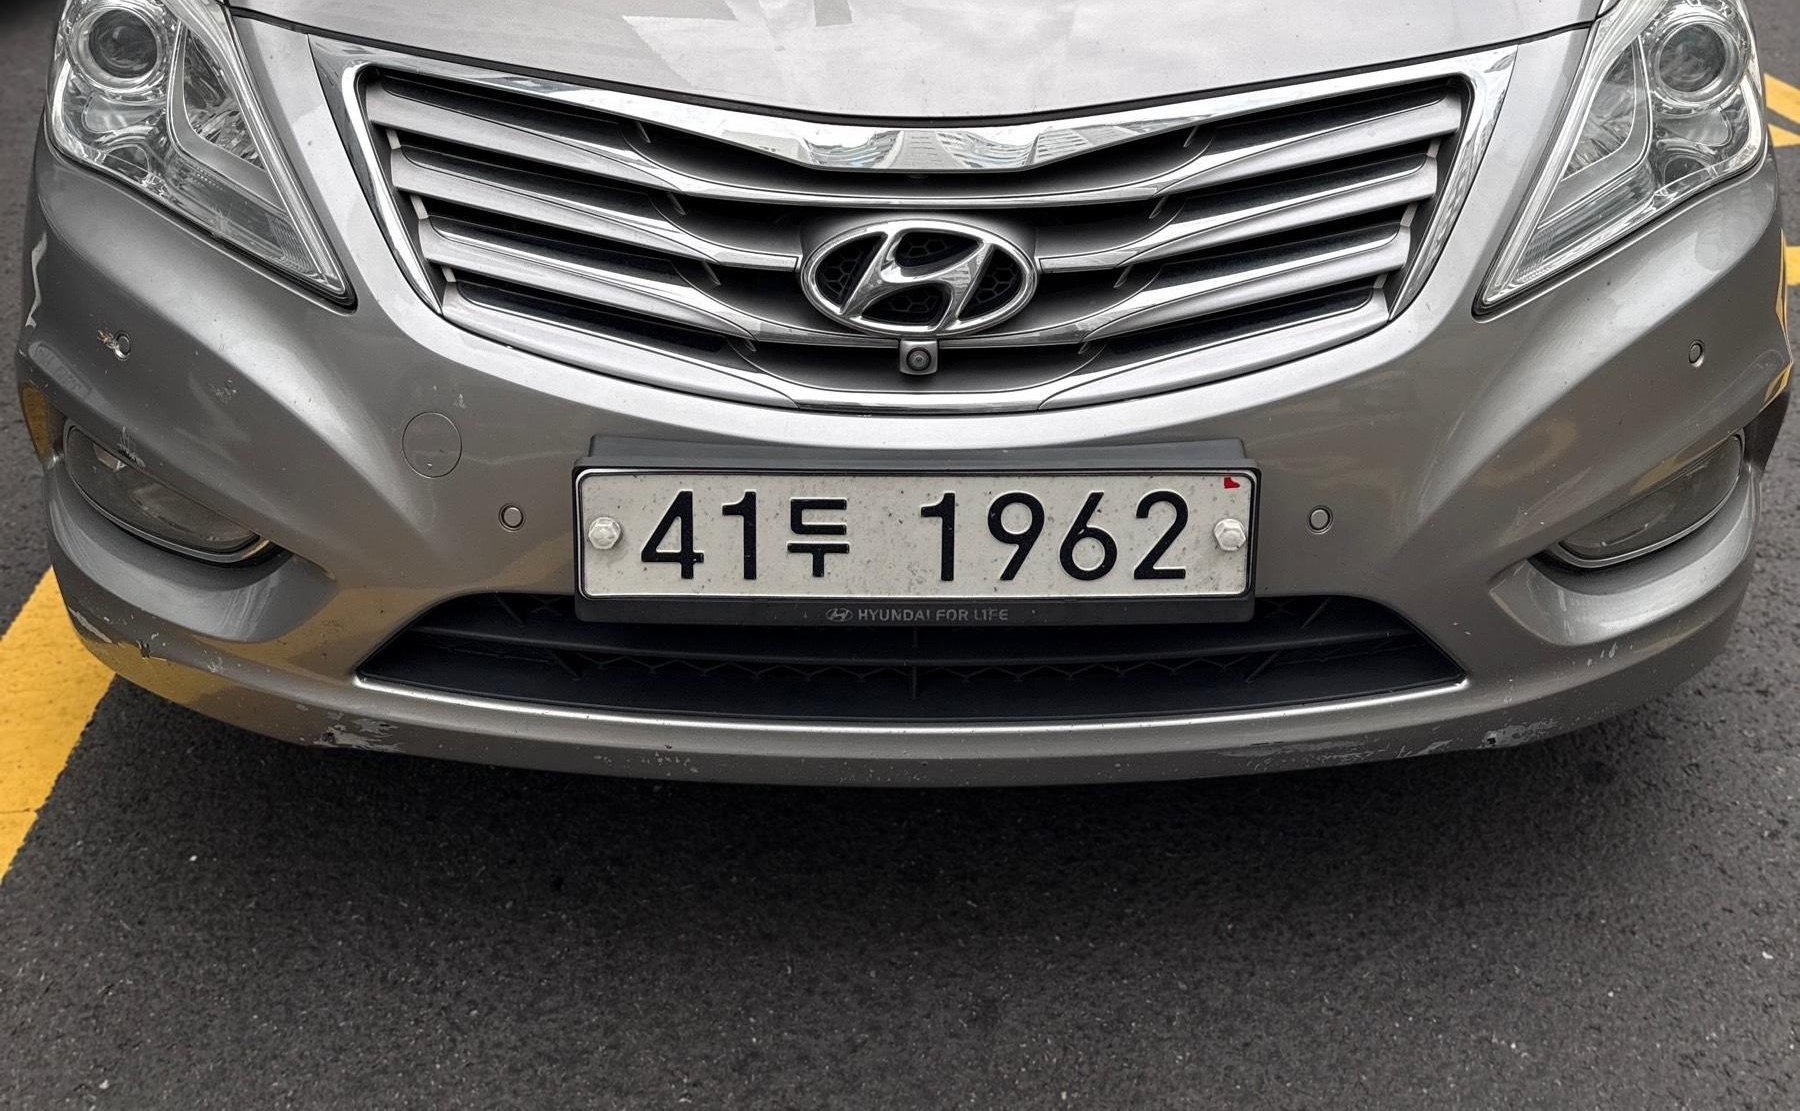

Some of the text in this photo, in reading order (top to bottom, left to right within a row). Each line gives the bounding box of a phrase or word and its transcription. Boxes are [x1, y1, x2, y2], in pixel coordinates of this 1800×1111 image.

[640, 490, 1189, 582] 41두 1962
[857, 607, 1010, 622] HYUNDAI FOR LIFE
